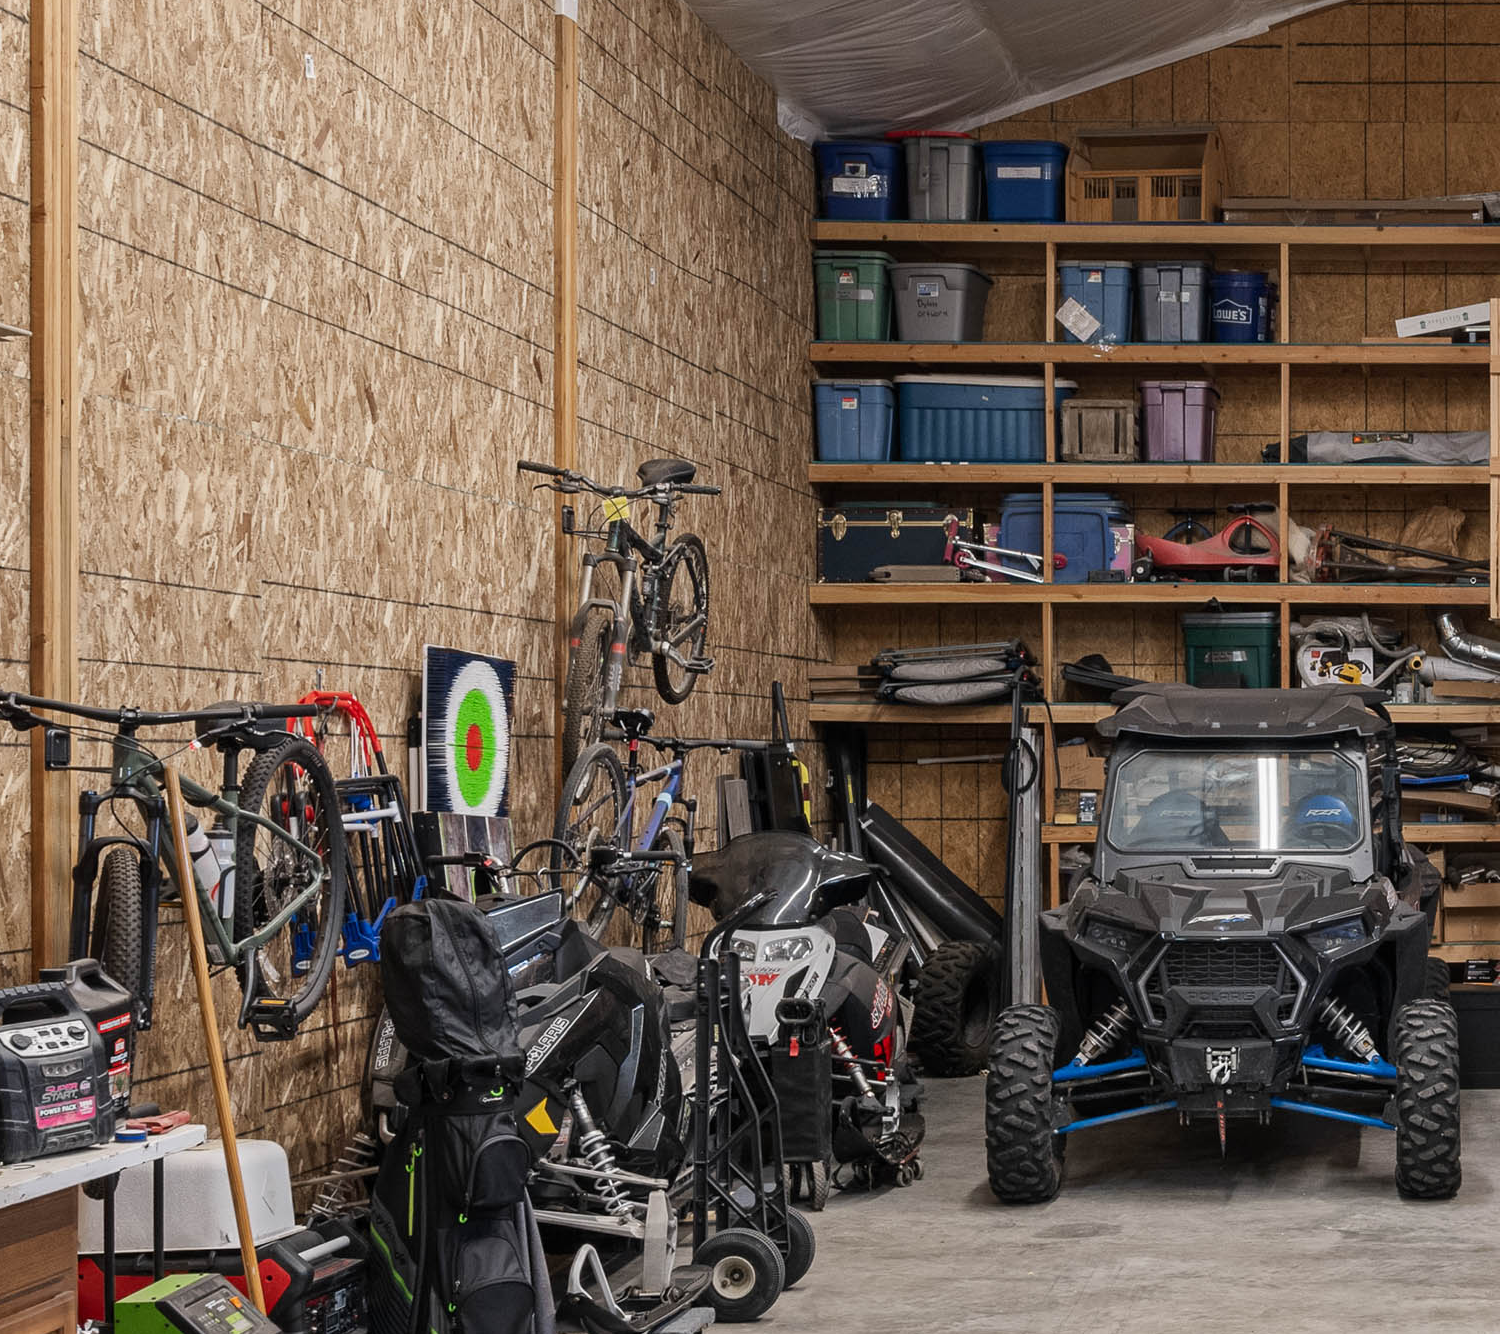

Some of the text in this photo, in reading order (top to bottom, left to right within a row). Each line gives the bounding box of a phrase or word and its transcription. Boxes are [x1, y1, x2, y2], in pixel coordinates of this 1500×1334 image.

[1213, 308, 1248, 321] LOWE'S
[1305, 809, 1341, 817] RZR
[1187, 992, 1255, 1001] POLARIS
[524, 1017, 570, 1071] POLARIS
[46, 1083, 78, 1092] SUPER
[42, 1089, 78, 1103] START
[40, 1104, 77, 1116] POWER PACK
